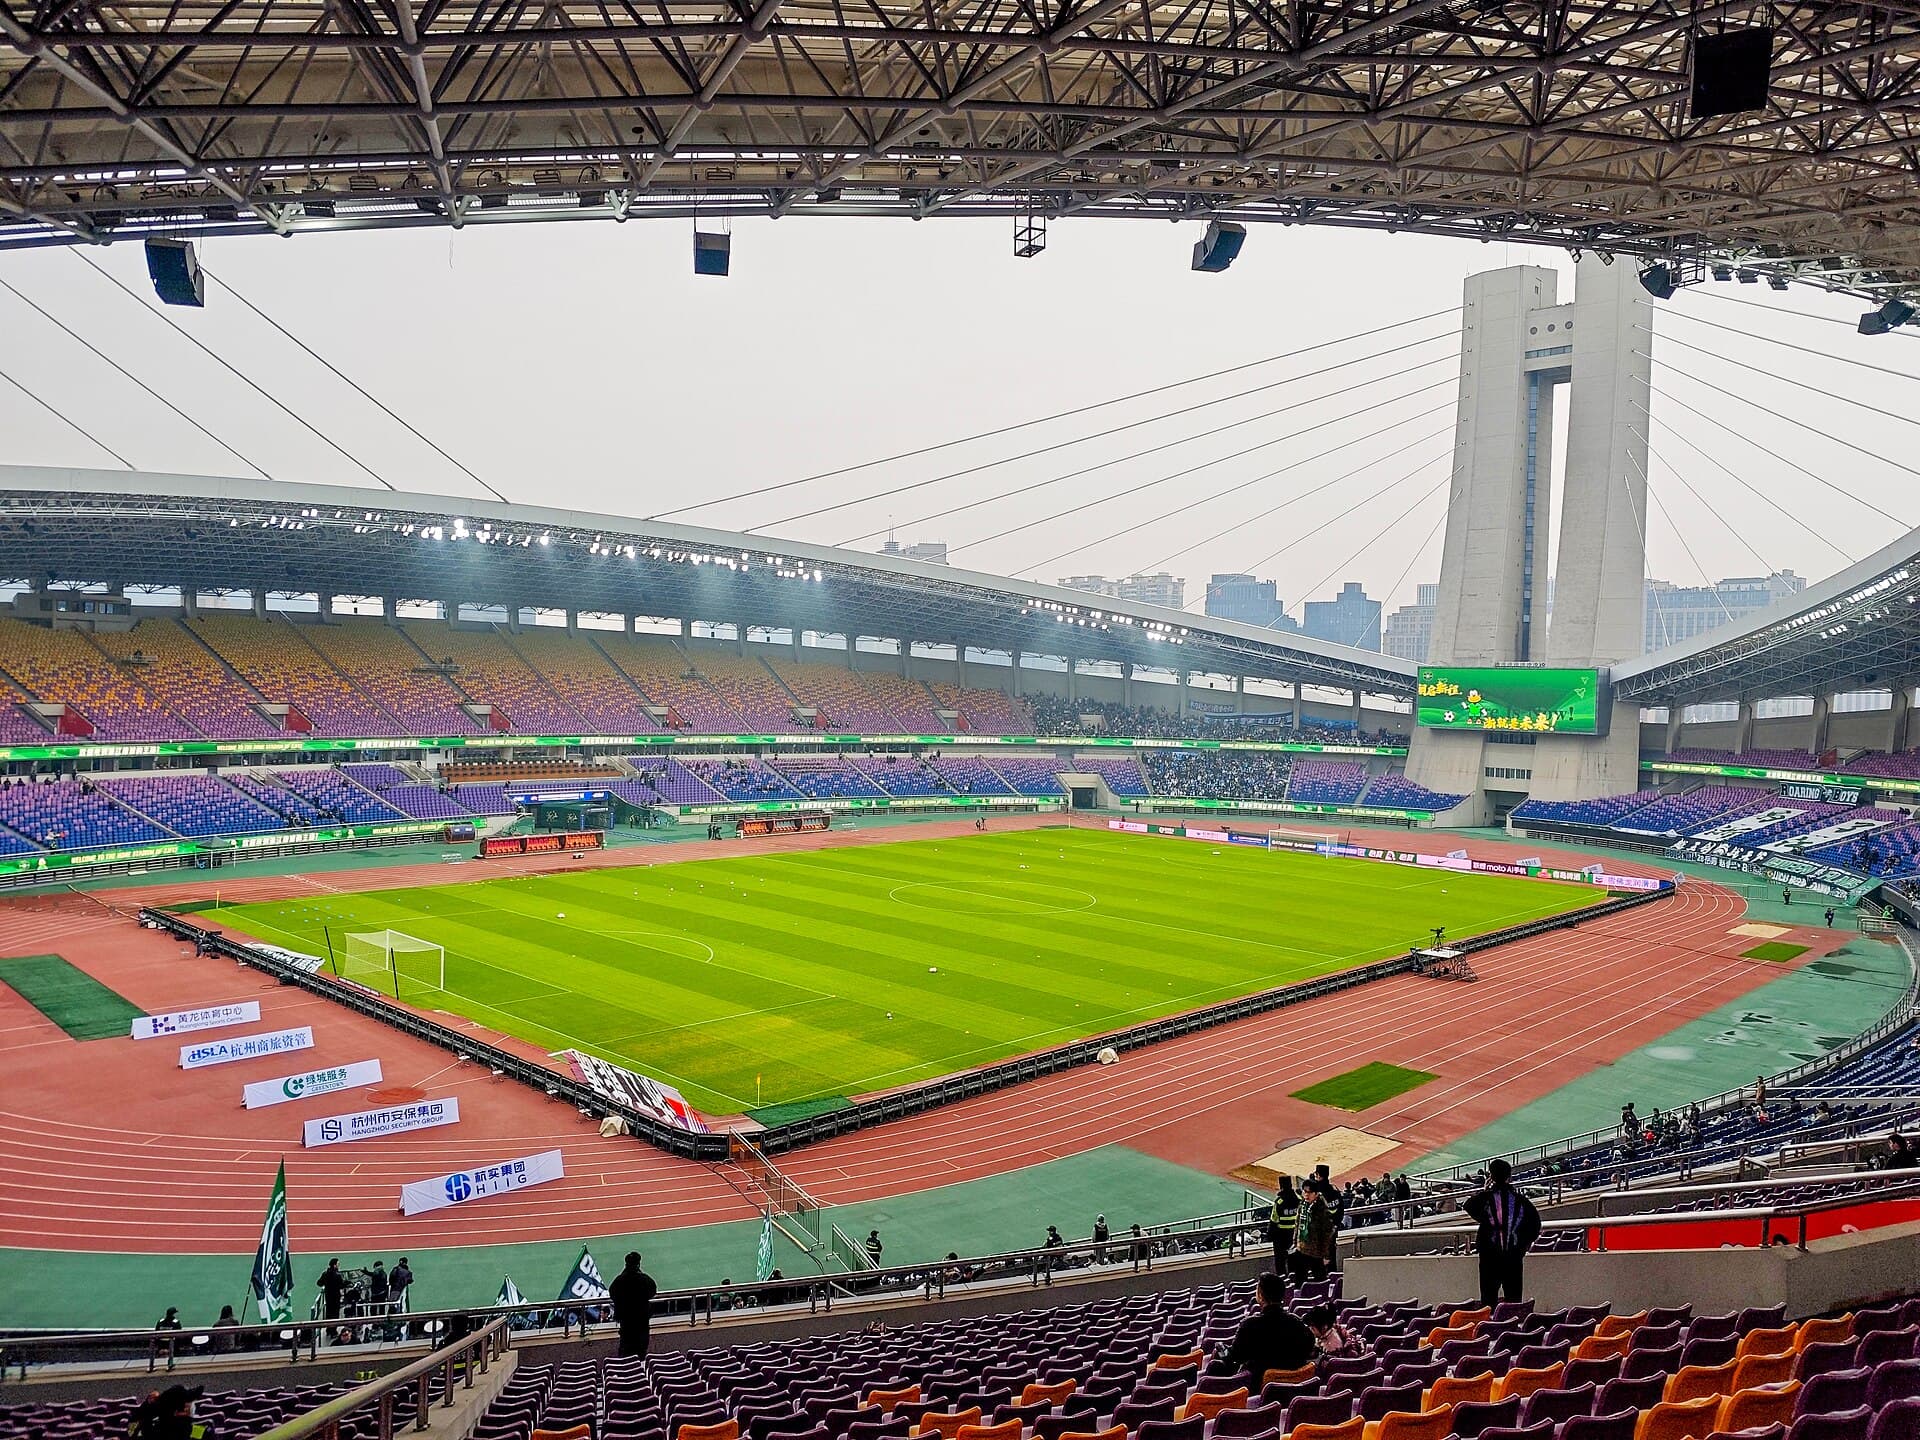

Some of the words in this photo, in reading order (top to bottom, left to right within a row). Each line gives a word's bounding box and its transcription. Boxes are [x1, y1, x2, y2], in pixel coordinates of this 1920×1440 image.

[1780, 783, 1820, 799] ROARING
[1833, 788, 1859, 802] BOYS
[178, 1006, 242, 1024] 黄龙体育中心
[190, 1045, 228, 1061] HSLA
[231, 1033, 306, 1057] 杭州商旅资管
[306, 1068, 347, 1084] 绿城服务
[311, 1081, 344, 1091] GREENTOWN
[351, 1103, 443, 1128] 杭州市安保集团
[351, 1125, 390, 1136] HANGZHOU
[391, 1119, 421, 1130] SECURITY
[421, 1115, 443, 1125] GROUP
[474, 1161, 525, 1183] 杭实集团
